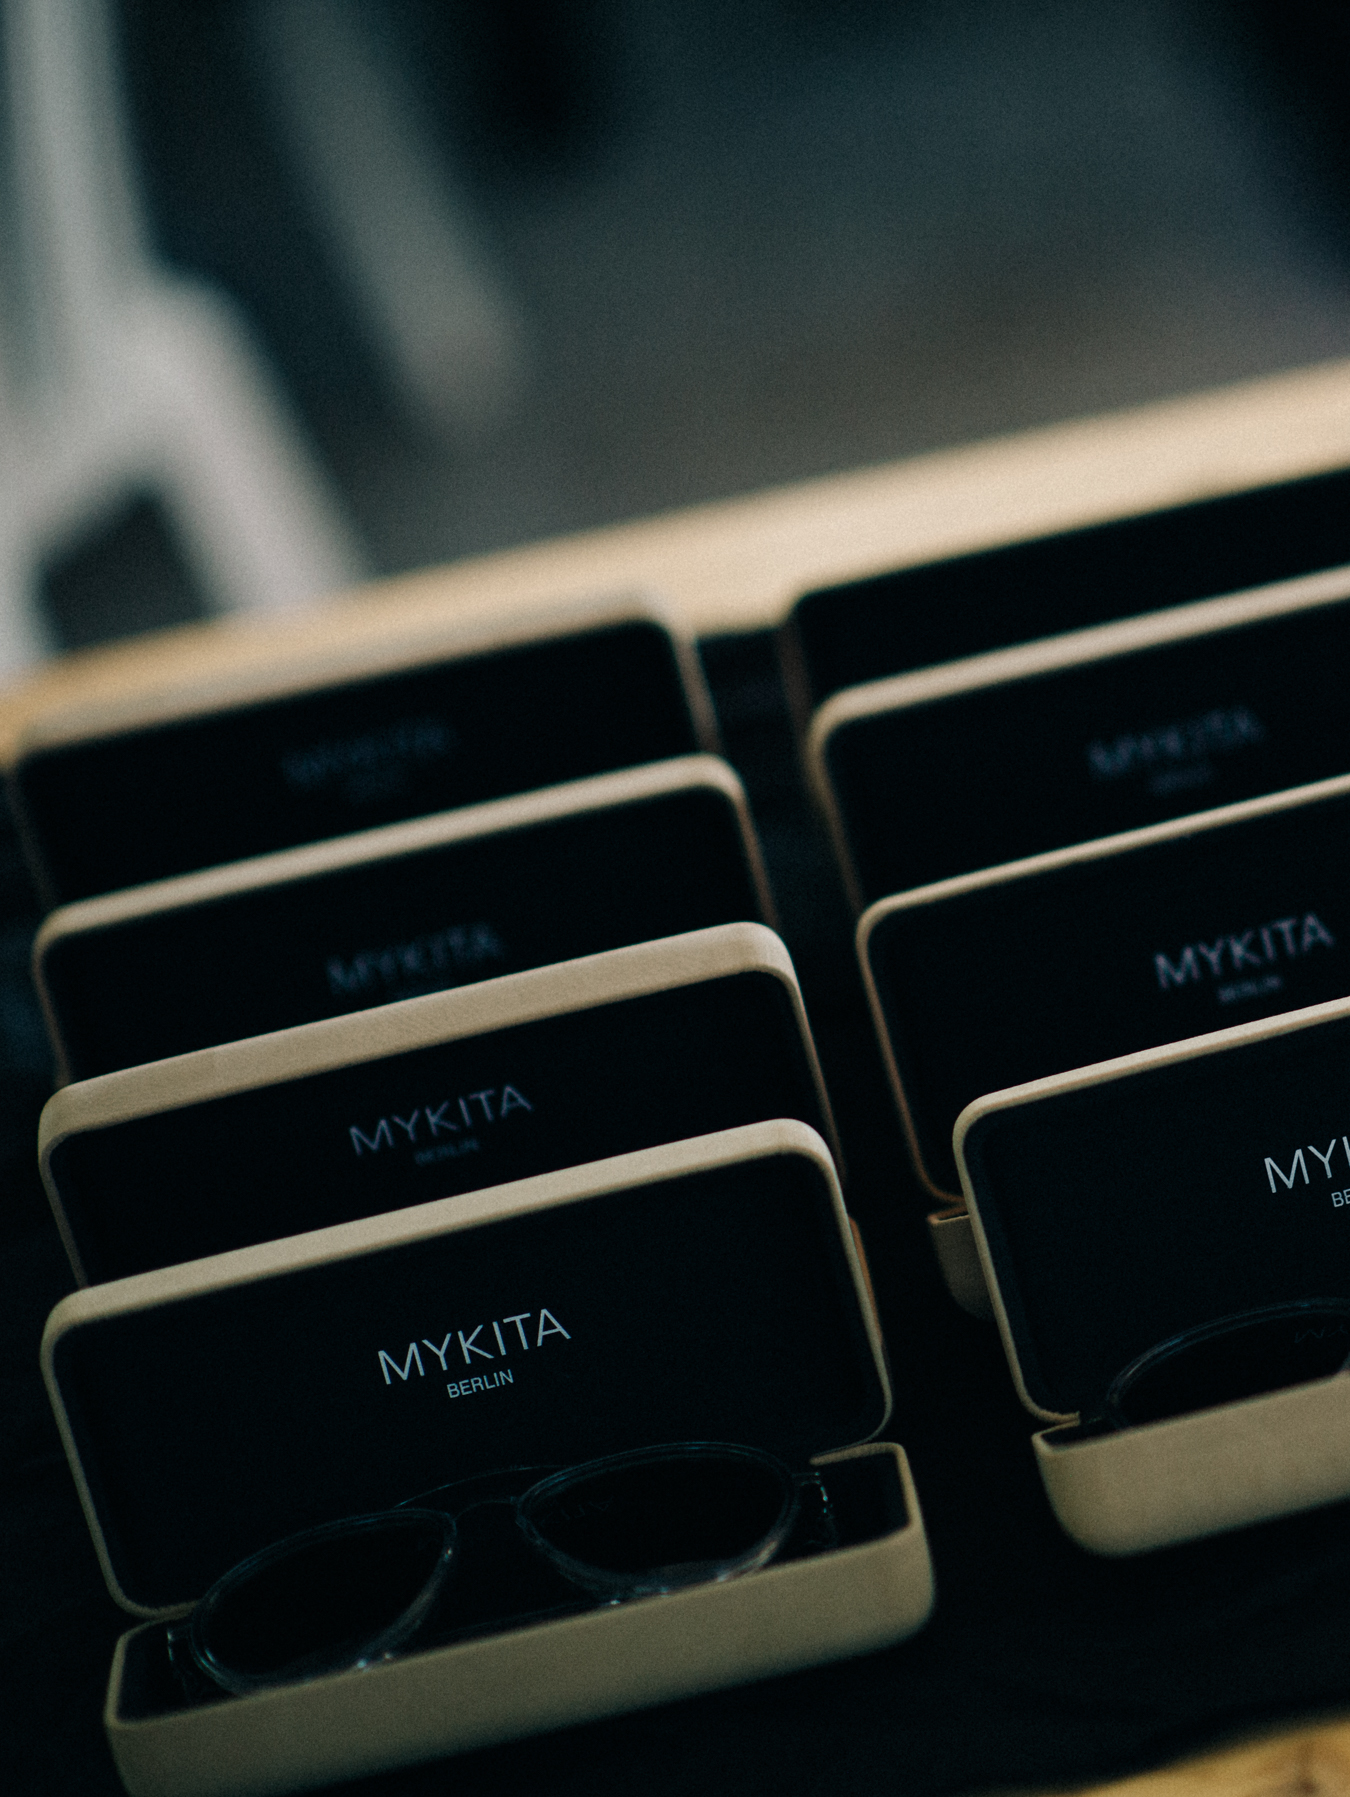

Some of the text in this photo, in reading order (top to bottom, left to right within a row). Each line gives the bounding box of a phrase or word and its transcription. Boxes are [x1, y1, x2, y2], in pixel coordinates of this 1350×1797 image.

[1154, 911, 1334, 990] MYKITA
[349, 1084, 534, 1157] MYKITA
[377, 1308, 571, 1385] MYKITA
[447, 1369, 514, 1399] BERLIN
